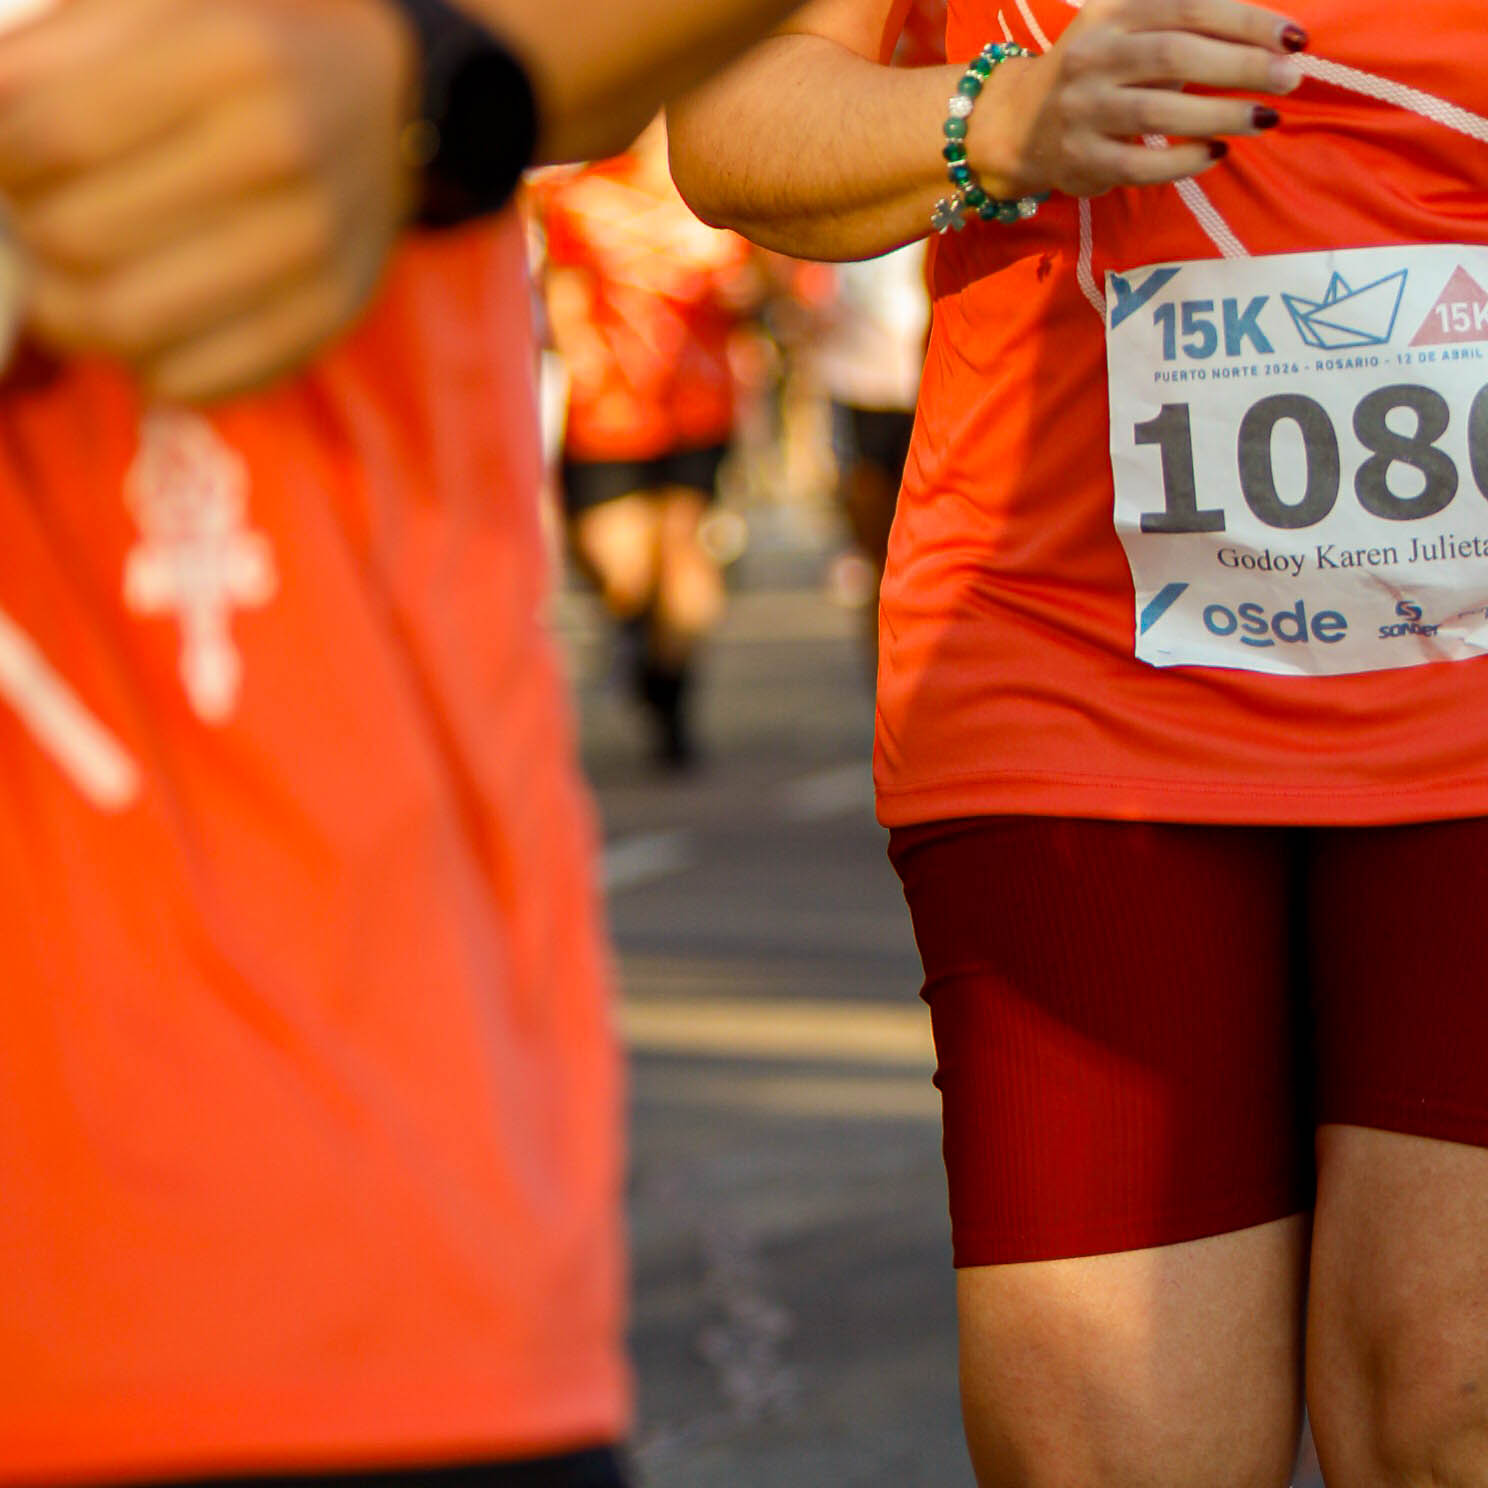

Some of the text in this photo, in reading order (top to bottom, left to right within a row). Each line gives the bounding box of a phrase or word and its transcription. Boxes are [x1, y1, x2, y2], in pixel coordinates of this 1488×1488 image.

[1153, 296, 1275, 361] 15K
[1154, 370, 1206, 383] PUERTO
[1212, 366, 1257, 380] NORTE
[1265, 362, 1299, 375] 2026
[1316, 357, 1378, 371] ROSARIO
[1397, 353, 1412, 365] 12
[1418, 351, 1435, 363] DE
[1442, 348, 1482, 361] ABRIL
[1217, 547, 1304, 576] Godoy
[1316, 544, 1398, 570] Karen
[1203, 599, 1348, 646] osde
